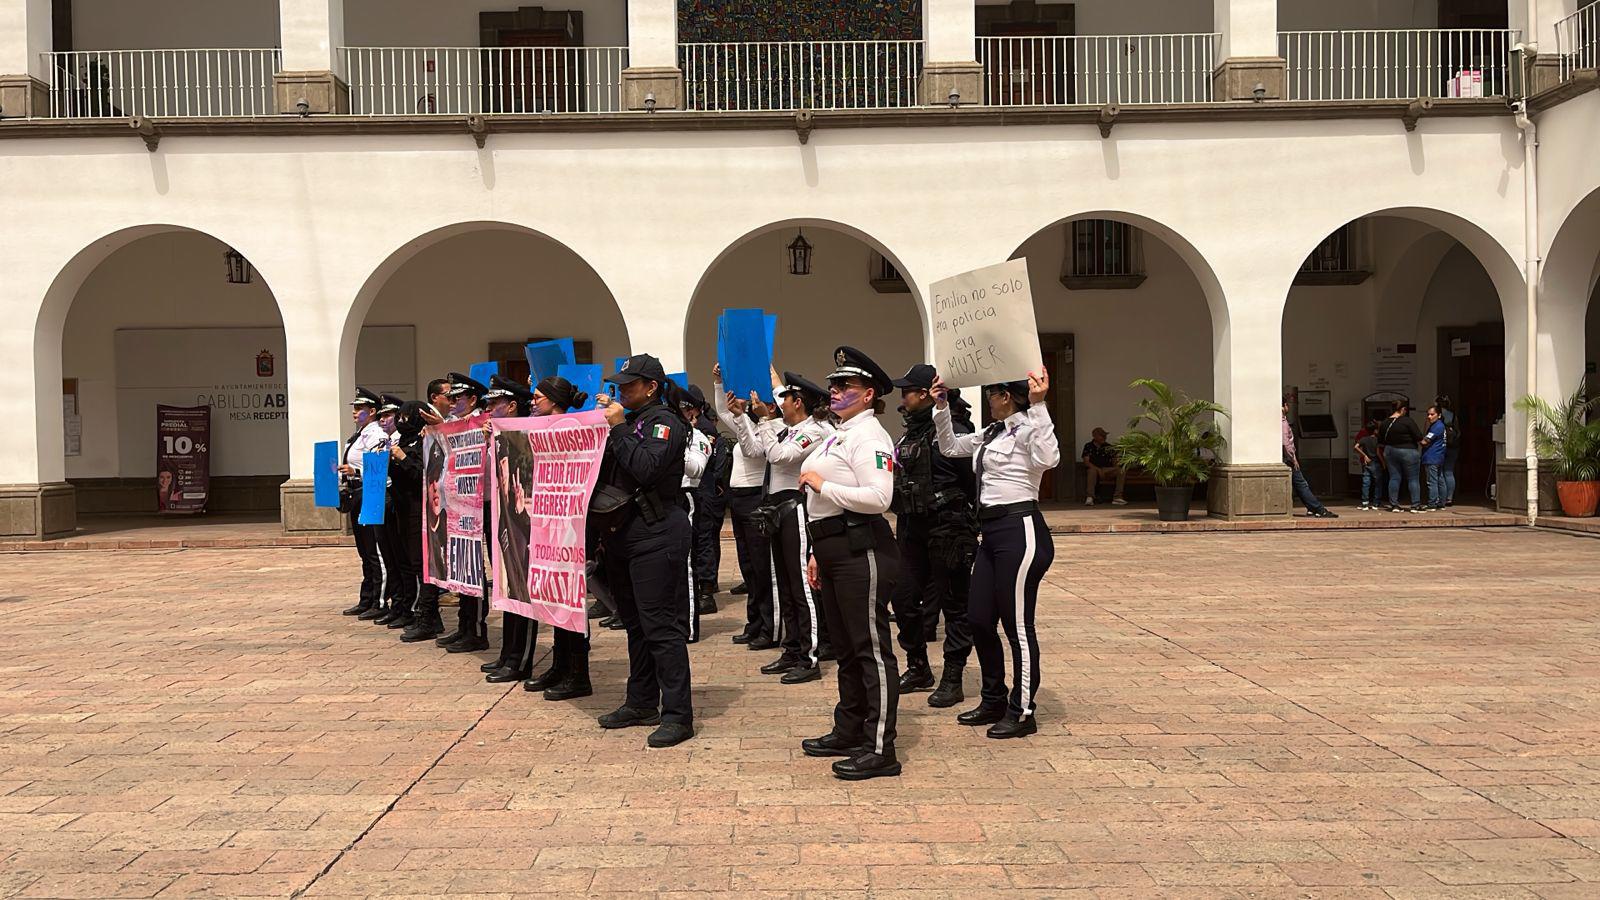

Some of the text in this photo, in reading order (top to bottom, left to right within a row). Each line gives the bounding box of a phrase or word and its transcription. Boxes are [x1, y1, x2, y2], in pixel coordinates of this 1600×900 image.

[935, 278, 1023, 314] Emilia no solo
[955, 335, 976, 351] era
[947, 344, 1005, 379] MUJER
[197, 393, 288, 409] CABILDO AB
[229, 412, 252, 421] MESA
[163, 435, 193, 455] 10
[547, 431, 558, 453] A
[555, 428, 596, 453] BUSCAR
[537, 461, 594, 485] MEJOR FUTUR
[532, 493, 569, 517] REGRESE
